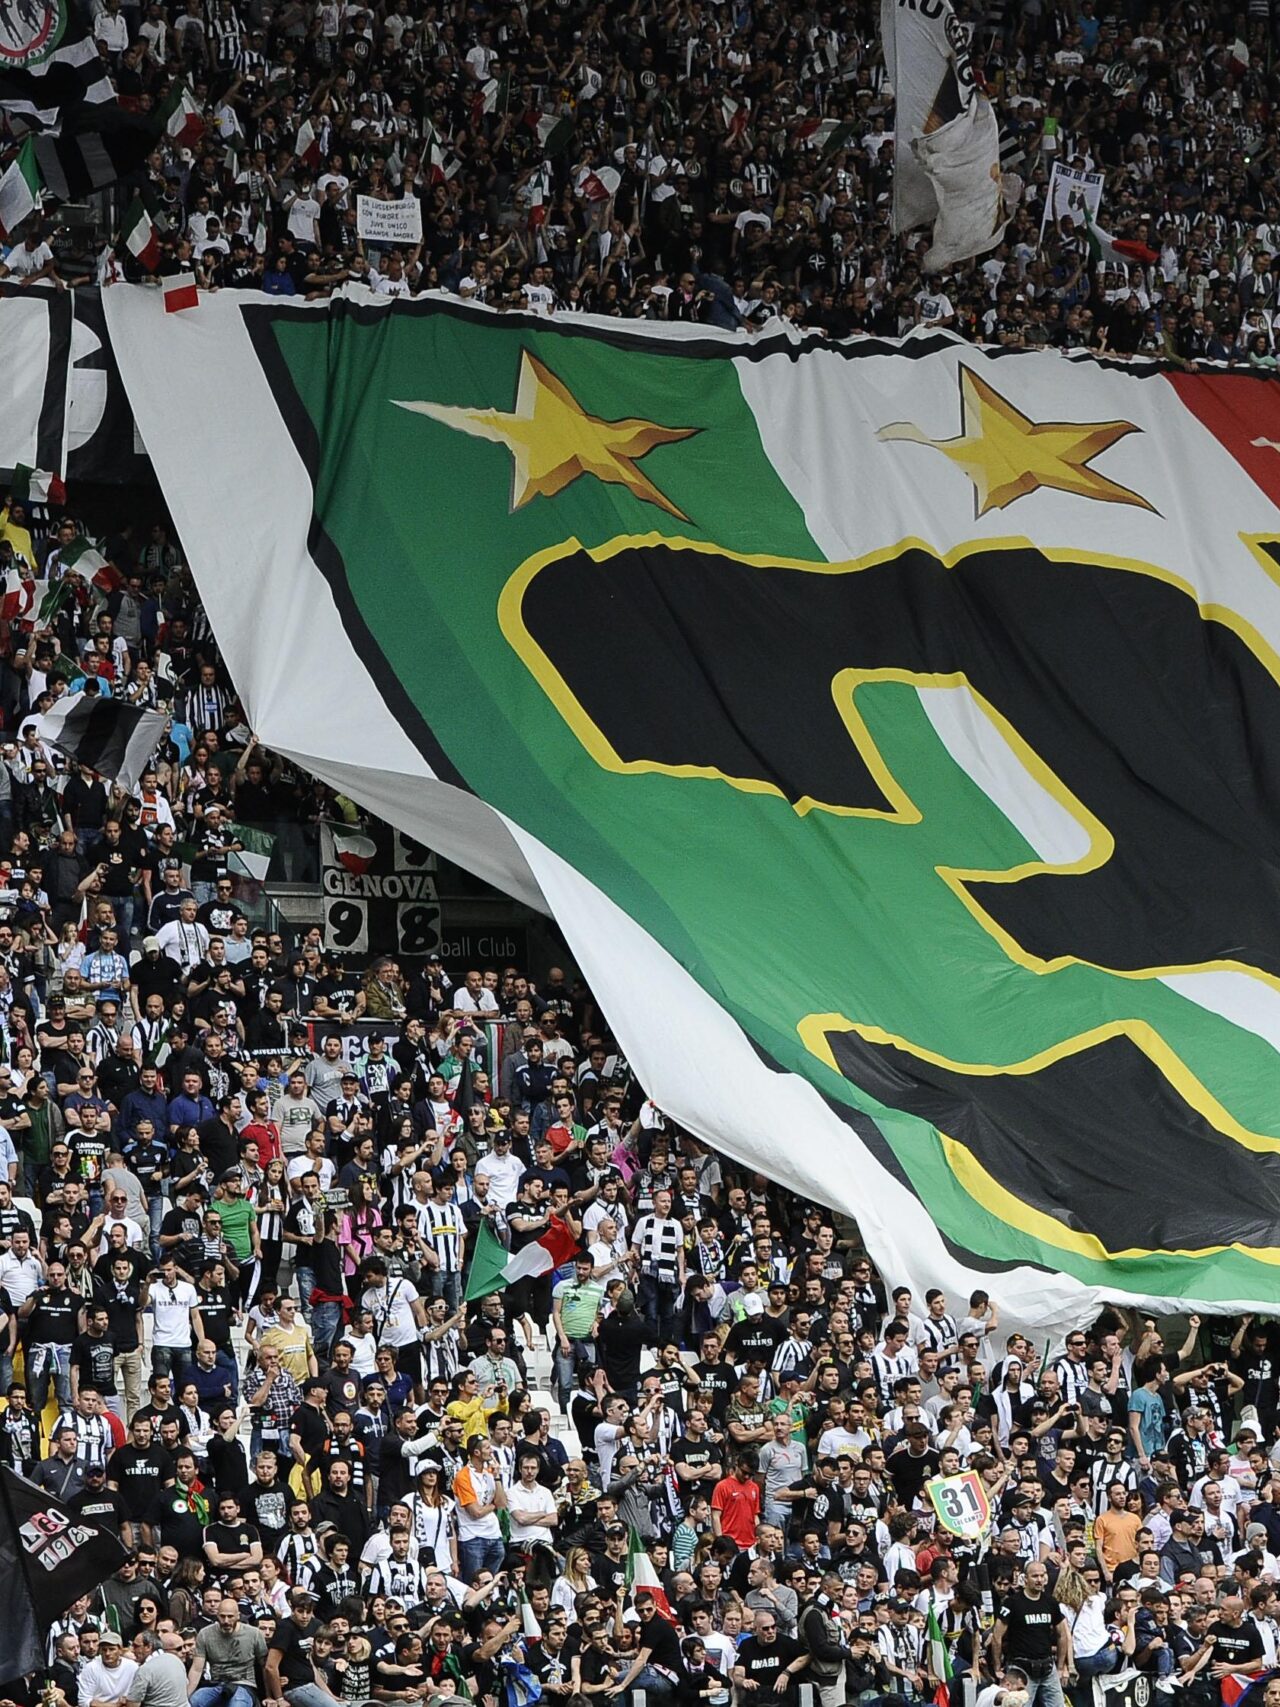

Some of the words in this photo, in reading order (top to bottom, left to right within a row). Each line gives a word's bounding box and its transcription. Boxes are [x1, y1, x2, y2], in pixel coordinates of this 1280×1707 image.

[370, 221, 384, 229] JUVE
[393, 232, 414, 240] AMORE
[323, 868, 440, 900] GENOVA
[478, 936, 516, 957] Club
[742, 1338, 773, 1347] VIKING
[700, 1380, 728, 1389] IKING
[125, 1466, 159, 1476] VIKING
[941, 1483, 979, 1517] 31
